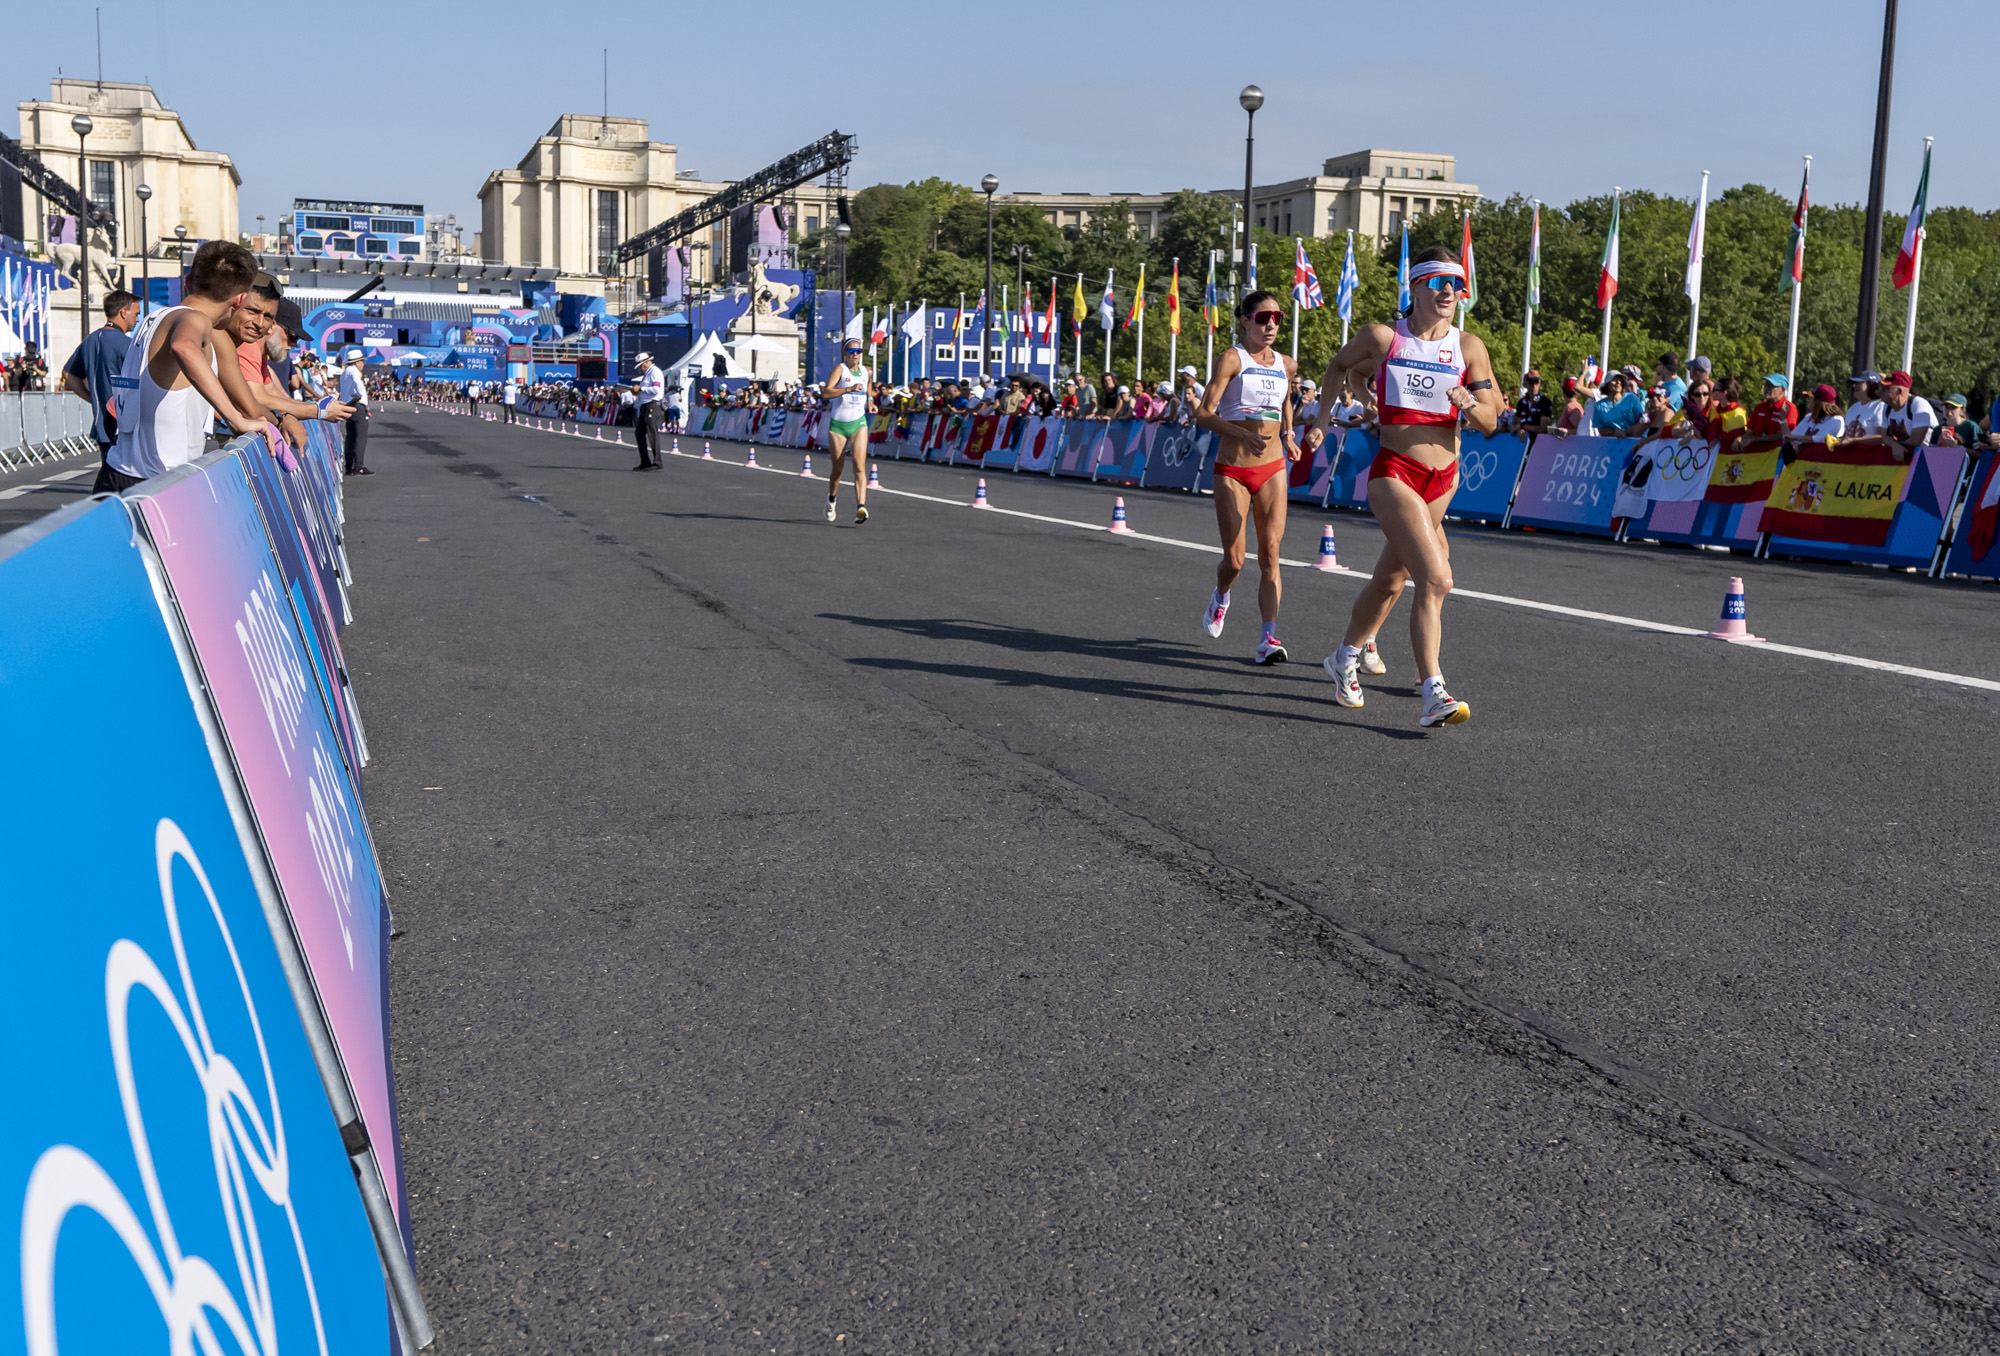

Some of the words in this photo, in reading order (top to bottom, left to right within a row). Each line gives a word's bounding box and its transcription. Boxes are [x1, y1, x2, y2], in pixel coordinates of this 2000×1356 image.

[1261, 380, 1275, 390] 131
[1406, 373, 1435, 389] 150
[1542, 480, 1601, 507] 2024
[1834, 481, 1892, 501] LAURA
